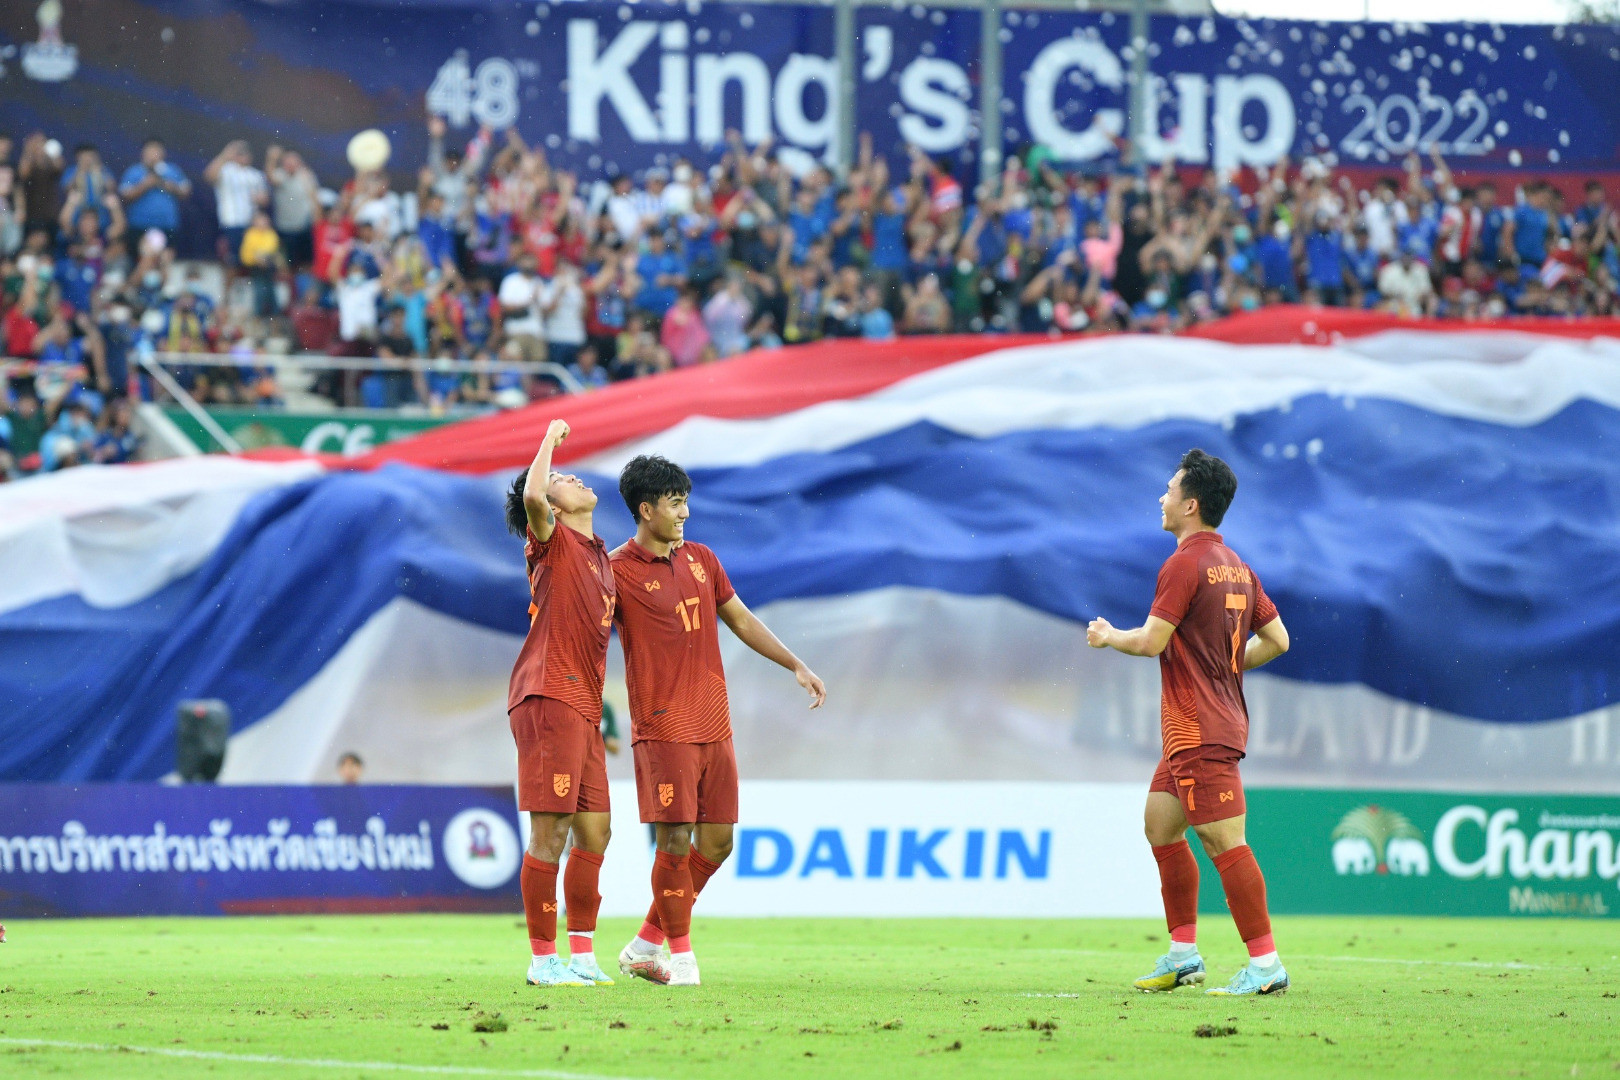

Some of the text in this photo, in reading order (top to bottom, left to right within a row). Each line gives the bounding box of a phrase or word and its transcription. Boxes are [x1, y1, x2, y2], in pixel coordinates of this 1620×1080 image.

[567, 18, 972, 178] King's
[1023, 35, 1296, 188] Cup
[1340, 93, 1489, 155] 2022
[675, 596, 701, 632] 17
[1225, 593, 1247, 673] 7
[1178, 778, 1197, 811] 7
[735, 828, 1052, 879] DAIKIN
[1432, 804, 1620, 892] Chan
